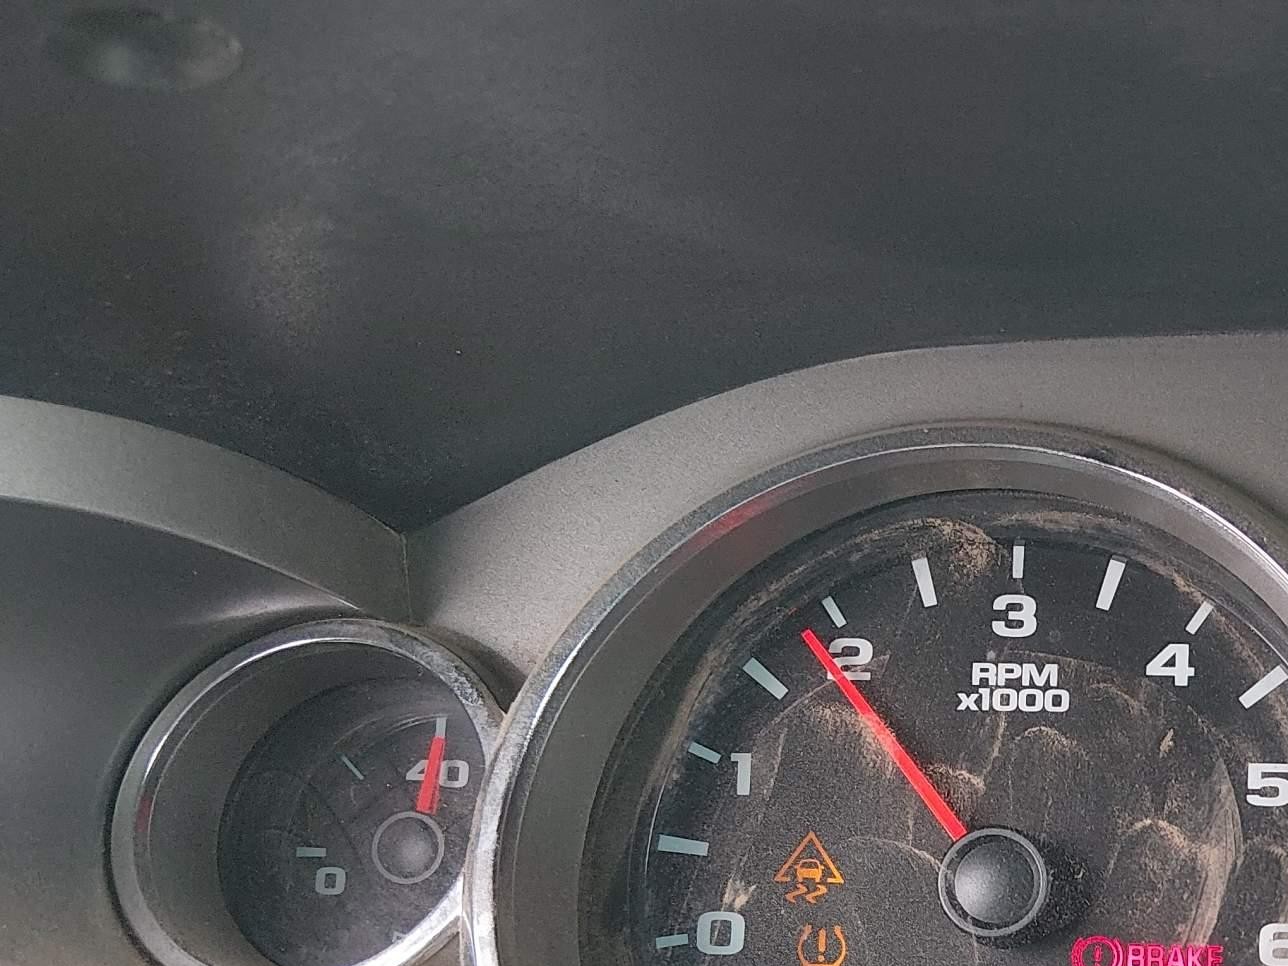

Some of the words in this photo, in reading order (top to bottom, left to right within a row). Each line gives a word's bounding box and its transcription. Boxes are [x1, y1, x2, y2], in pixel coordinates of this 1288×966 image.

[991, 594, 1037, 637] 3
[827, 637, 874, 682] 2
[971, 662, 1059, 687] RPM
[1145, 643, 1195, 686] 4
[956, 688, 1070, 713] x1000
[405, 759, 469, 788] 40
[729, 752, 752, 796] 1
[313, 866, 347, 896] 0
[696, 911, 746, 956] 0
